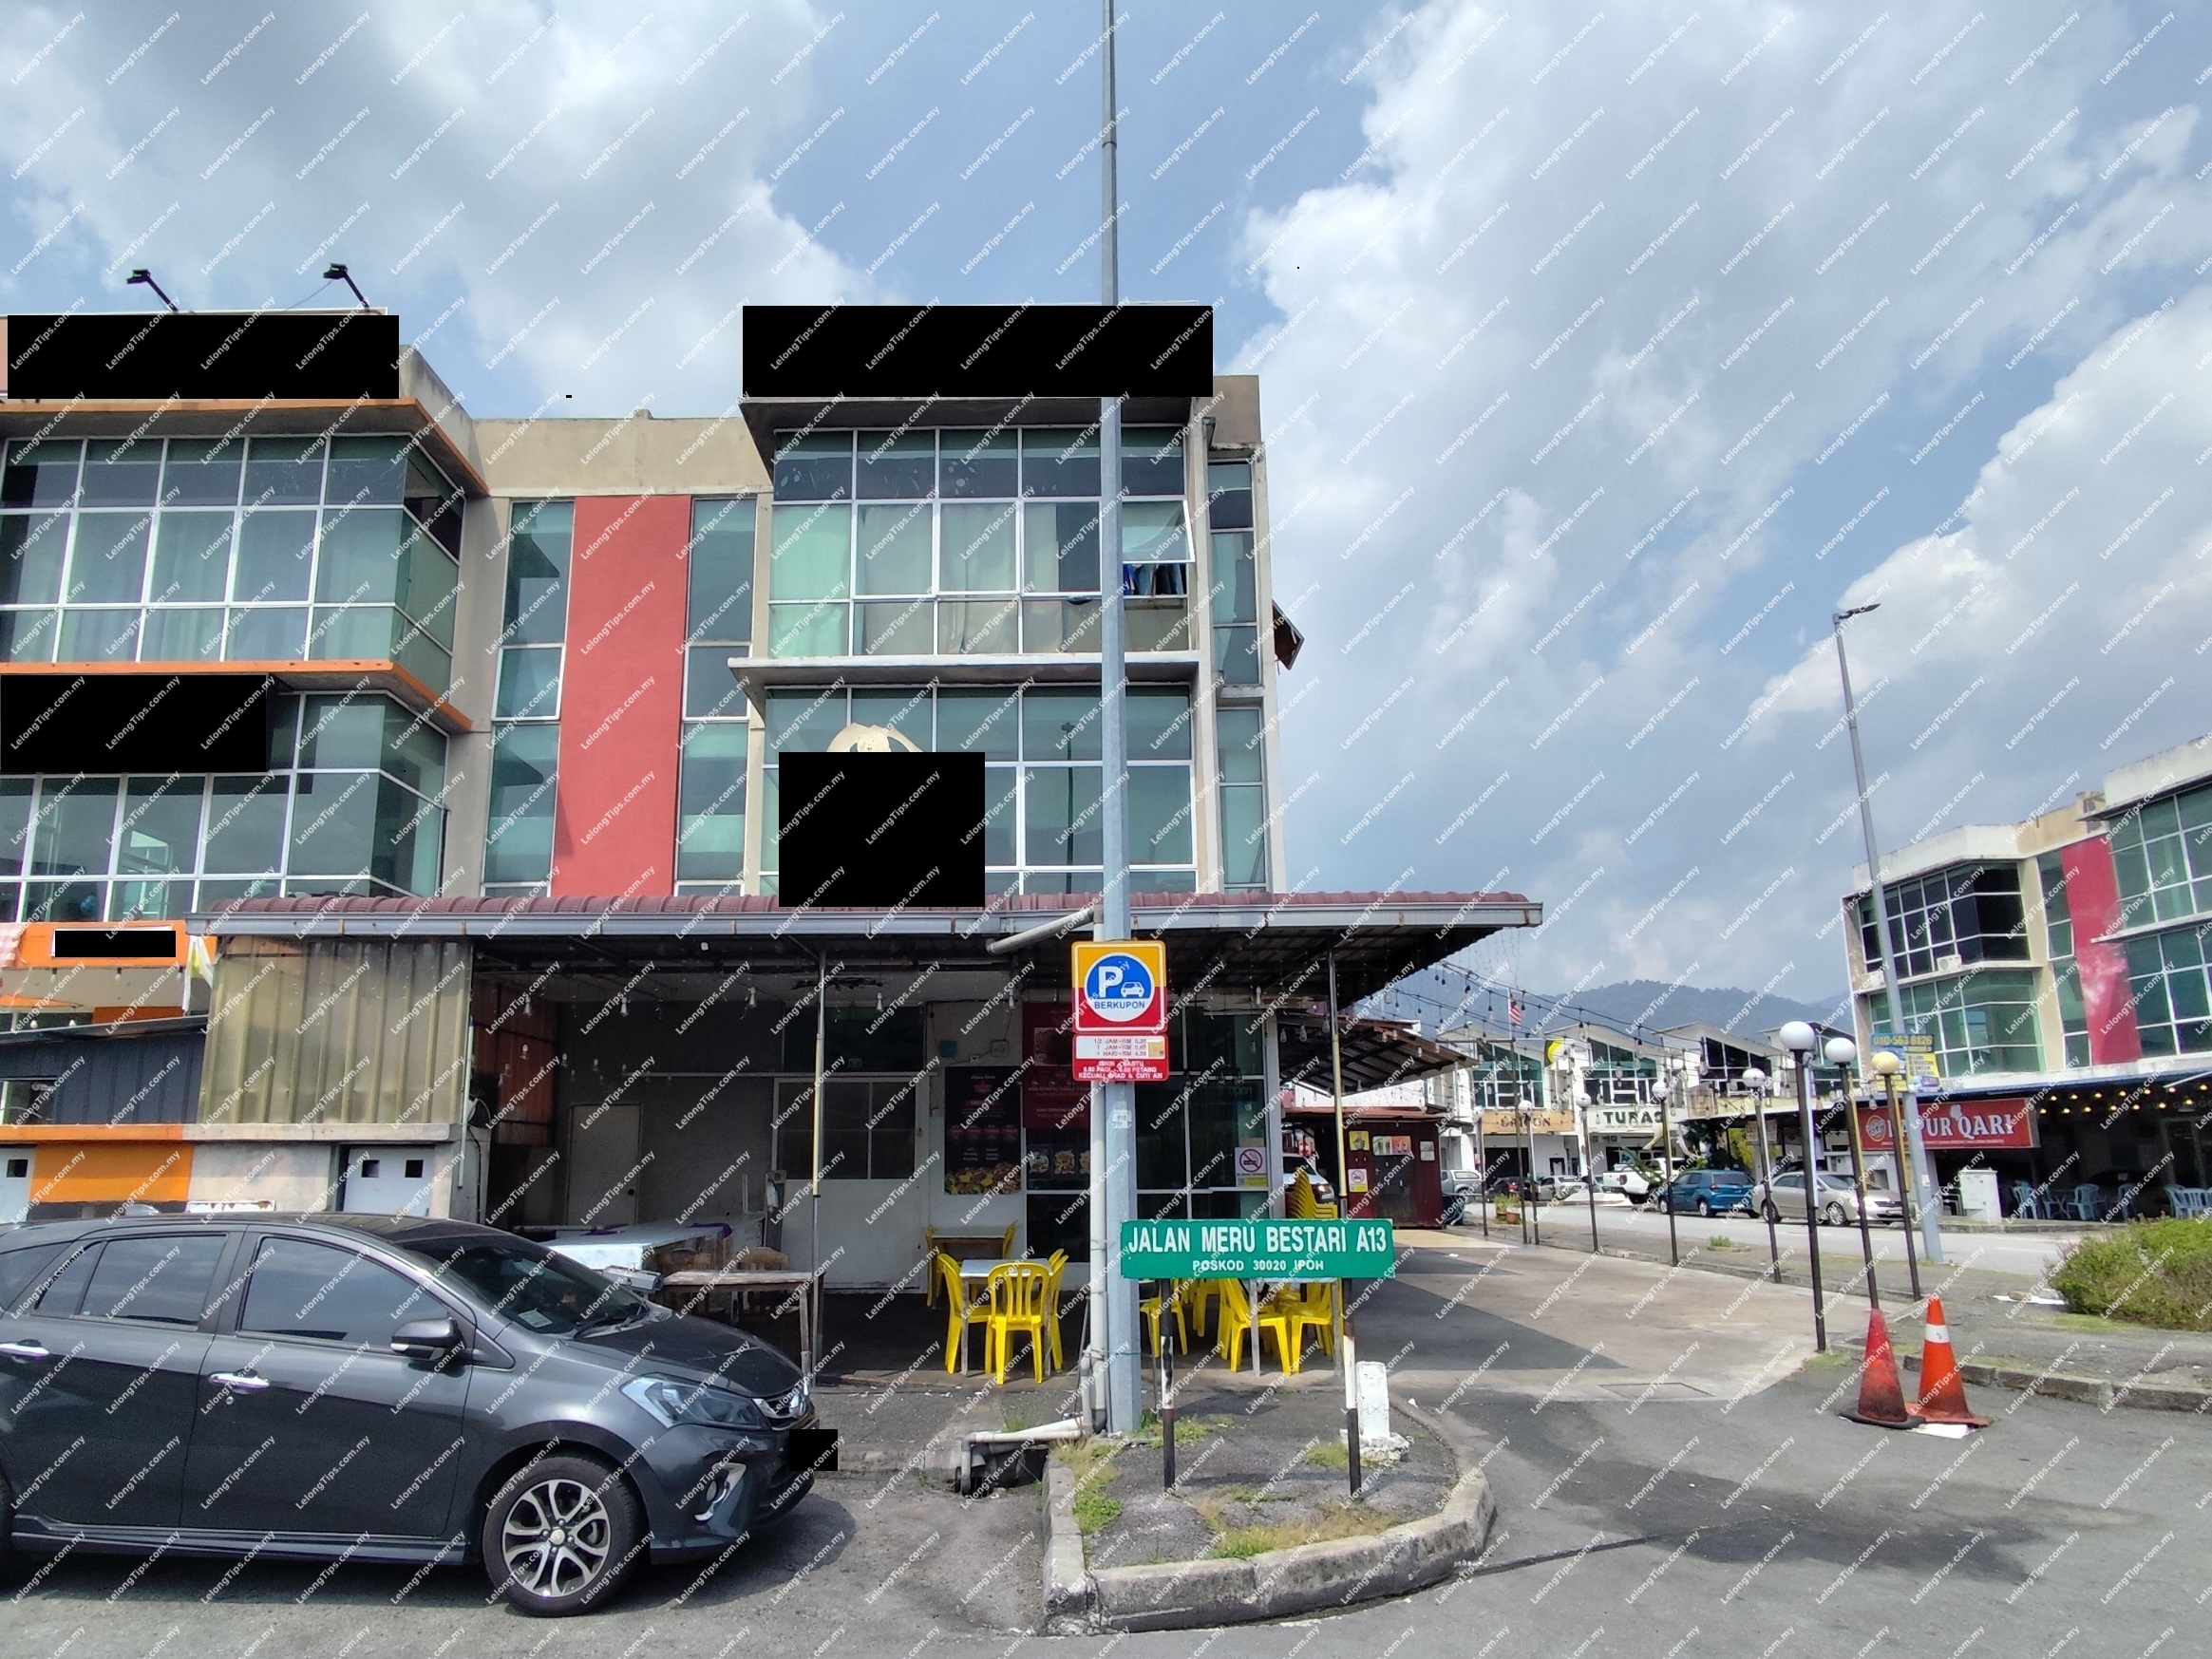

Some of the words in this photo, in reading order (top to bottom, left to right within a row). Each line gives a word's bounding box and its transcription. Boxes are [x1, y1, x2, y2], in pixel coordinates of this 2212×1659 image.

[1098, 966, 1124, 998] P
[1094, 1001, 1145, 1009] BERKUPON
[1957, 1114, 2014, 1141] QARI
[1128, 1227, 1191, 1253] JALAN
[1201, 1226, 1255, 1253] MERU
[1266, 1226, 1347, 1253] BESTARI
[1356, 1226, 1387, 1252] A13
[1192, 1260, 1244, 1272] POSKOD
[1253, 1260, 1287, 1272] 30020
[1294, 1260, 1324, 1271] IPOH
